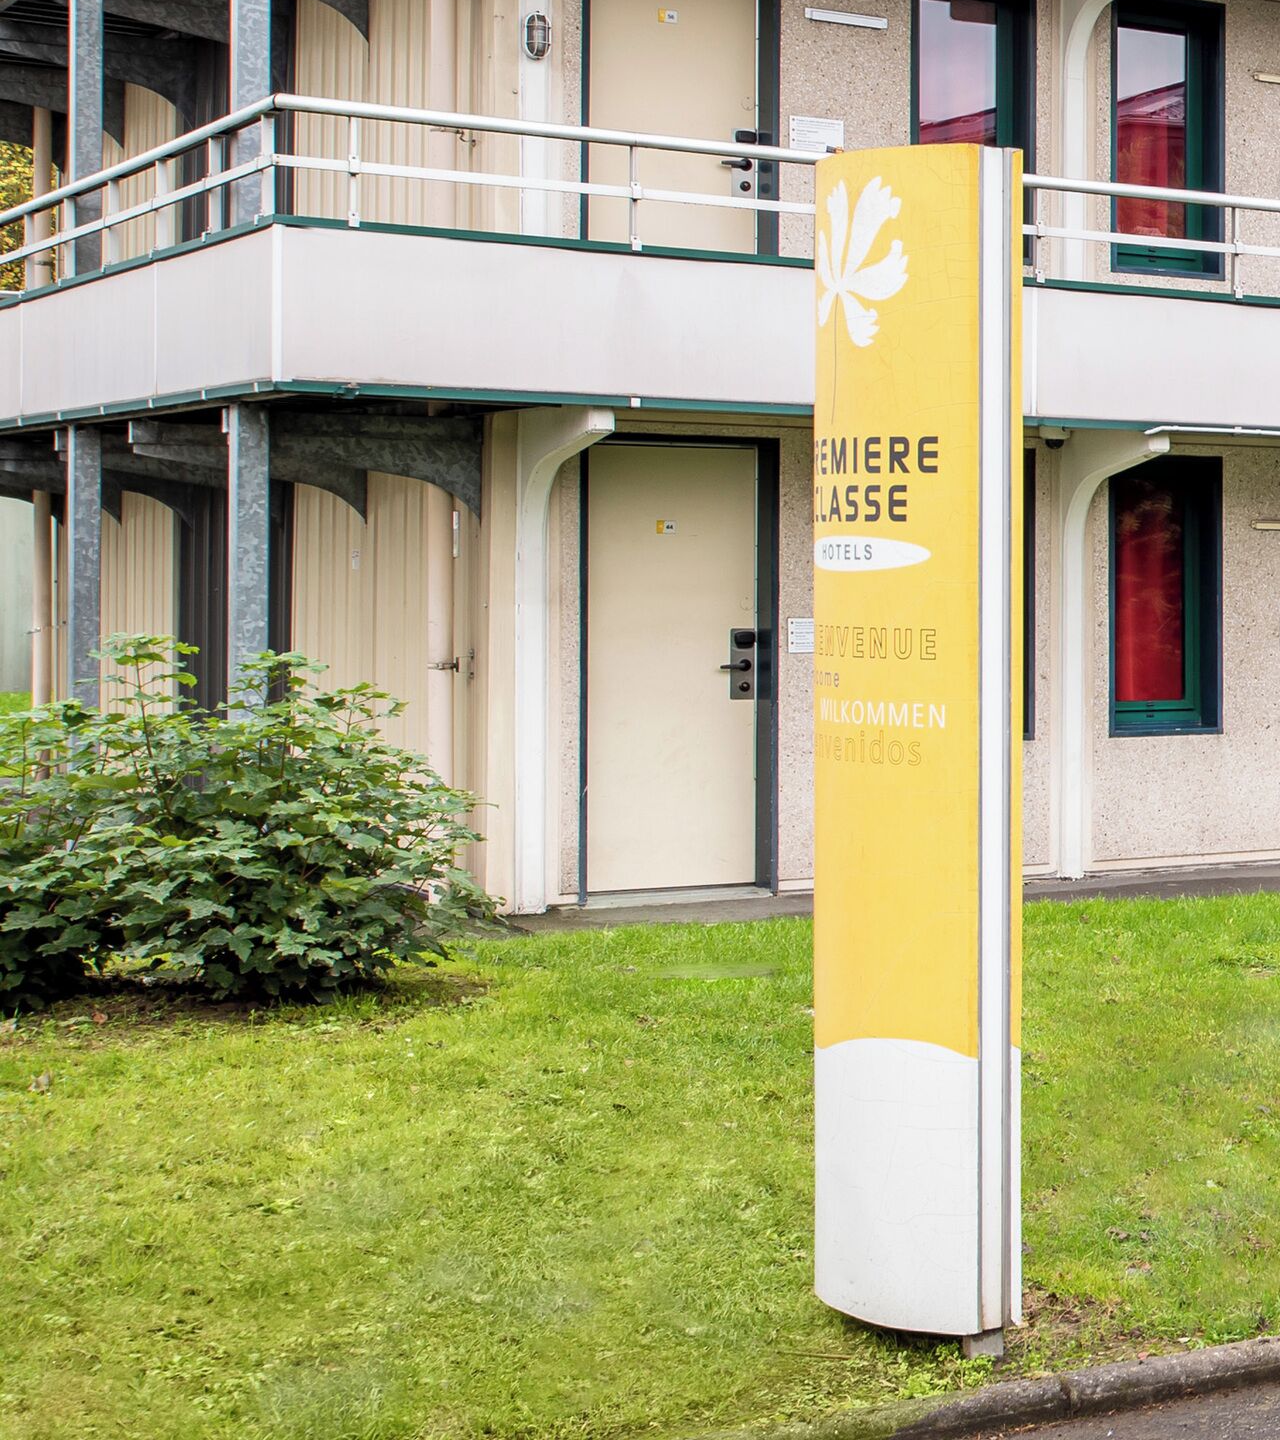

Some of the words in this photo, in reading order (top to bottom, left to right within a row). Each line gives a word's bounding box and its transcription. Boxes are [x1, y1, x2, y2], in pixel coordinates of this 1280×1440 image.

[815, 435, 939, 476] REMIERE
[822, 543, 873, 561] HOTELS
[820, 696, 946, 729] WILKOMMEN
